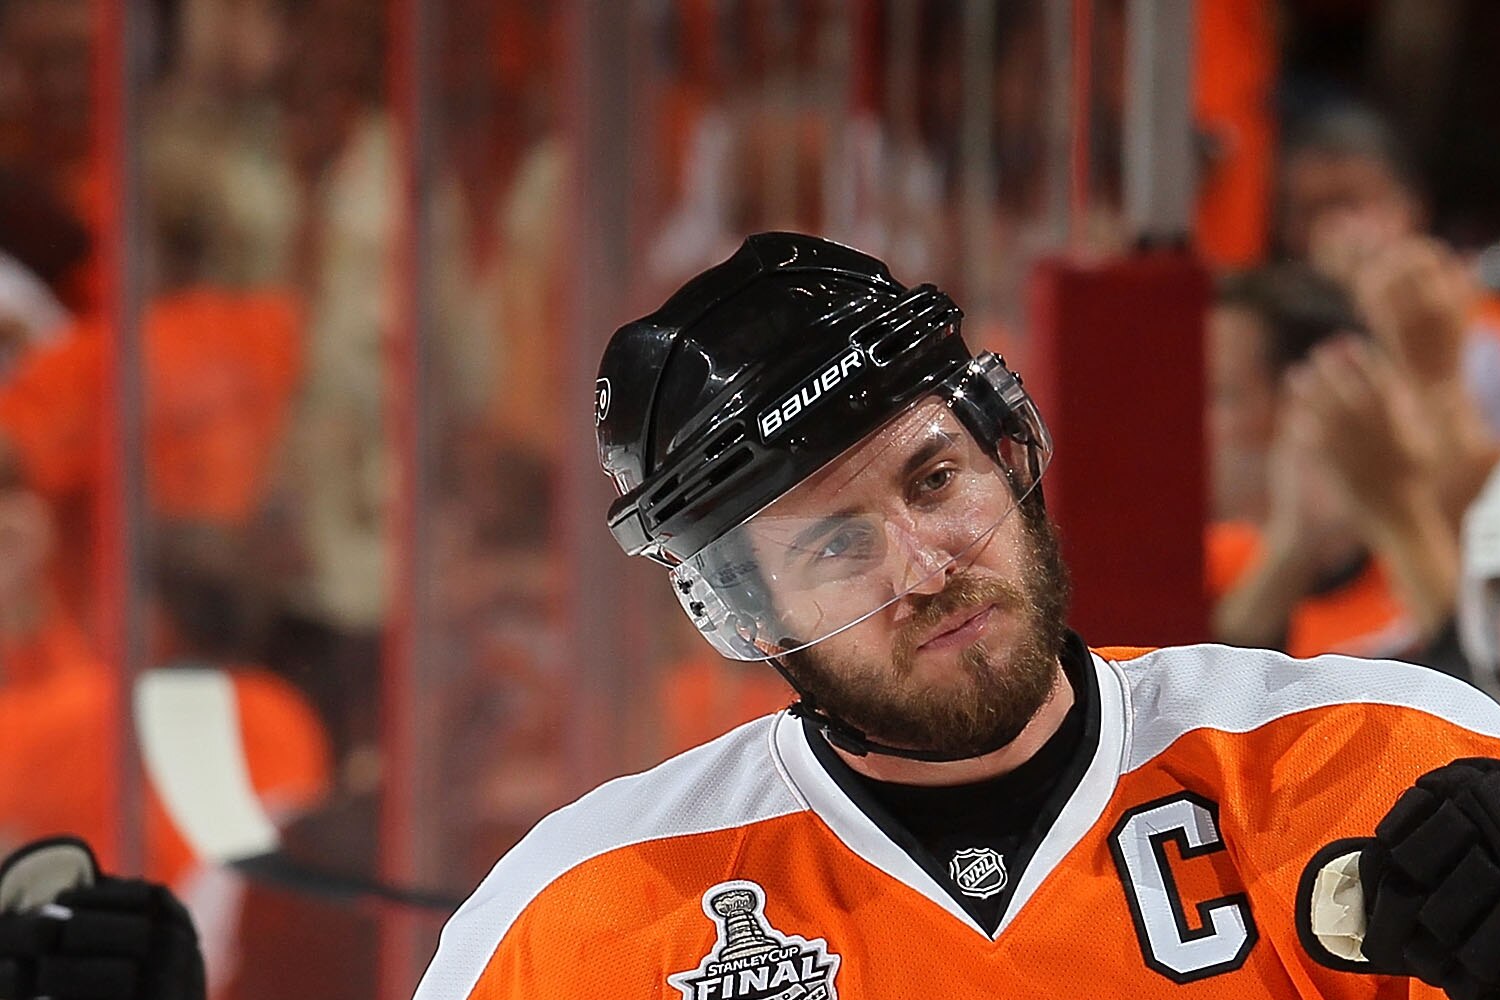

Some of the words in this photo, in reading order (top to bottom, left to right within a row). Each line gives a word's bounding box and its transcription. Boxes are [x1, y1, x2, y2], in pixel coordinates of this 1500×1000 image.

[962, 854, 999, 887] NHL
[1106, 790, 1260, 985] C
[707, 954, 769, 977] STANLEY
[769, 946, 799, 963] CUP
